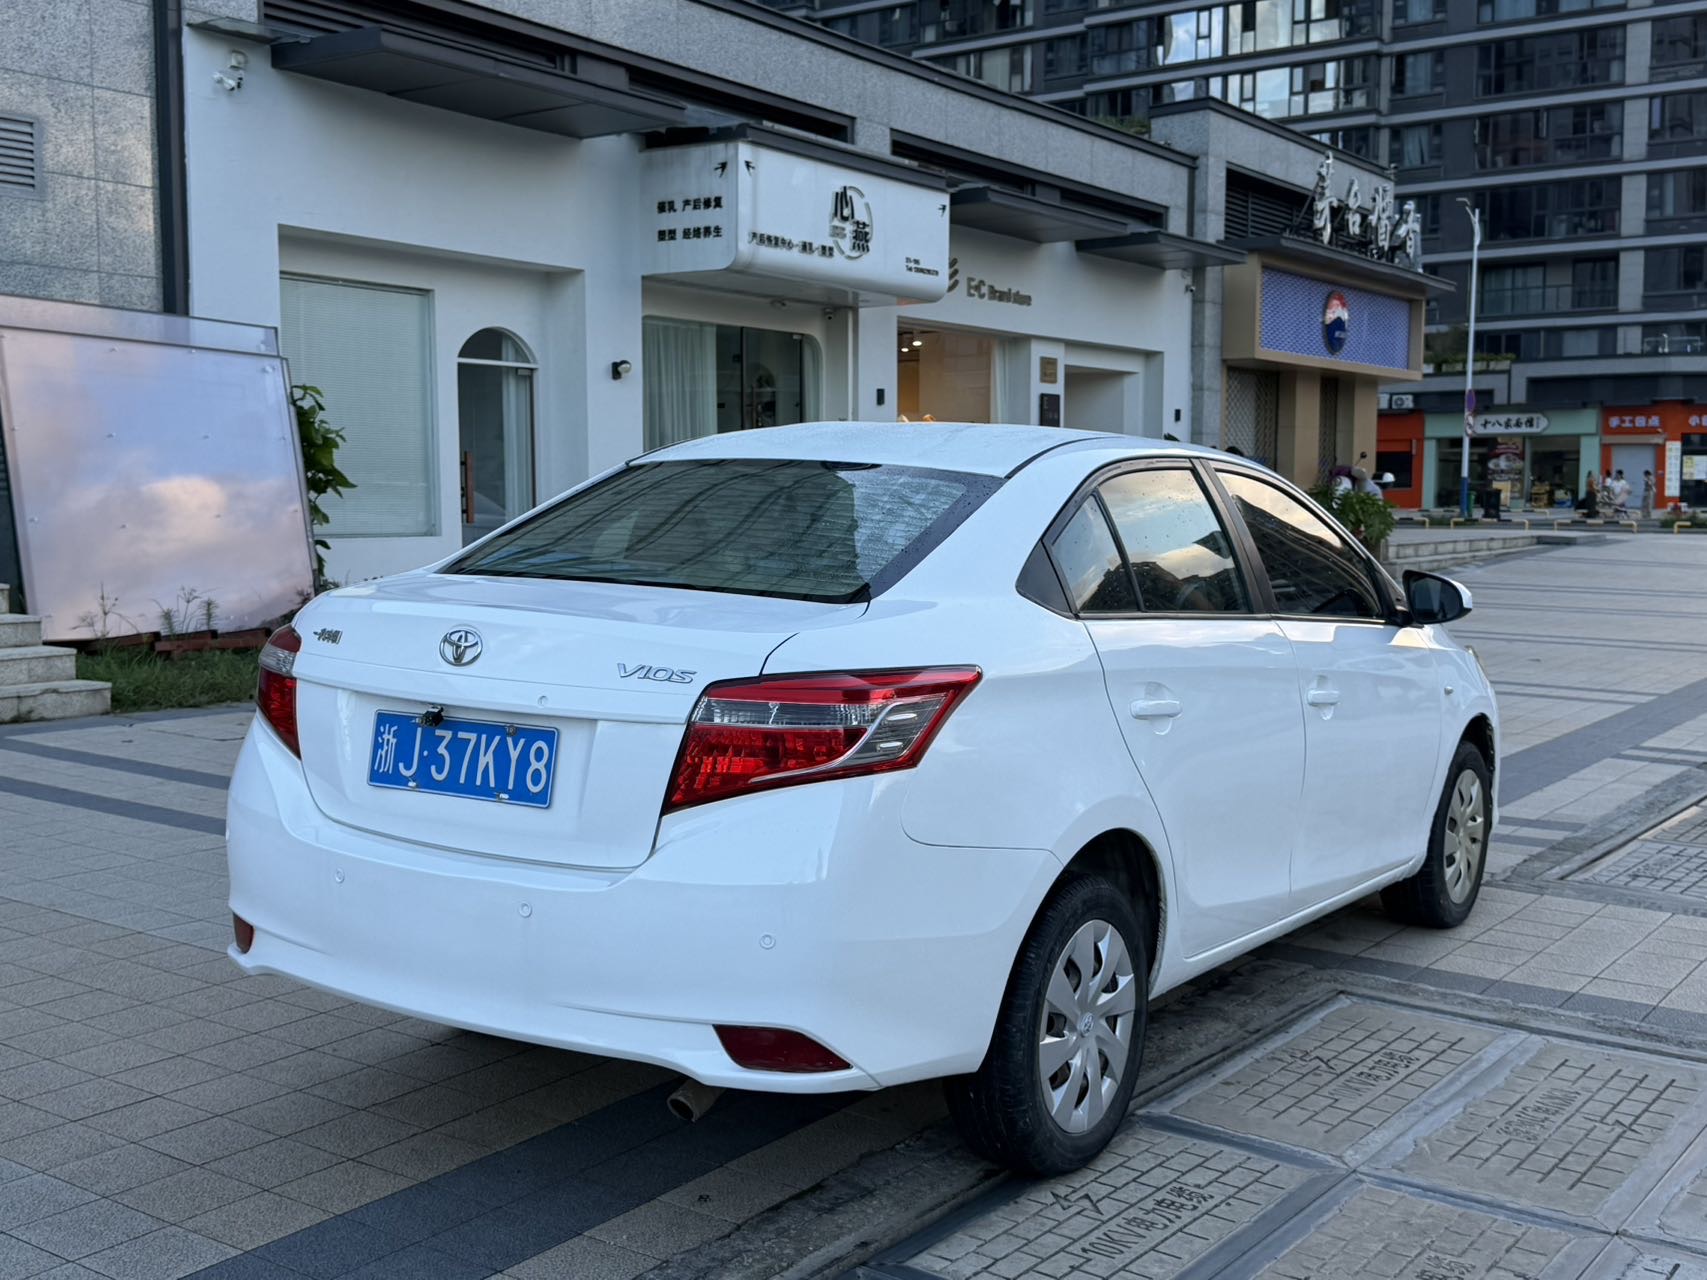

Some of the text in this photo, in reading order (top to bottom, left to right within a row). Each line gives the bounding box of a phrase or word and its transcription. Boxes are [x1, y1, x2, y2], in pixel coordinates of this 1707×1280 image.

[616, 662, 698, 684] VIOS
[1080, 1184, 1215, 1260] 10KV电力电缆
